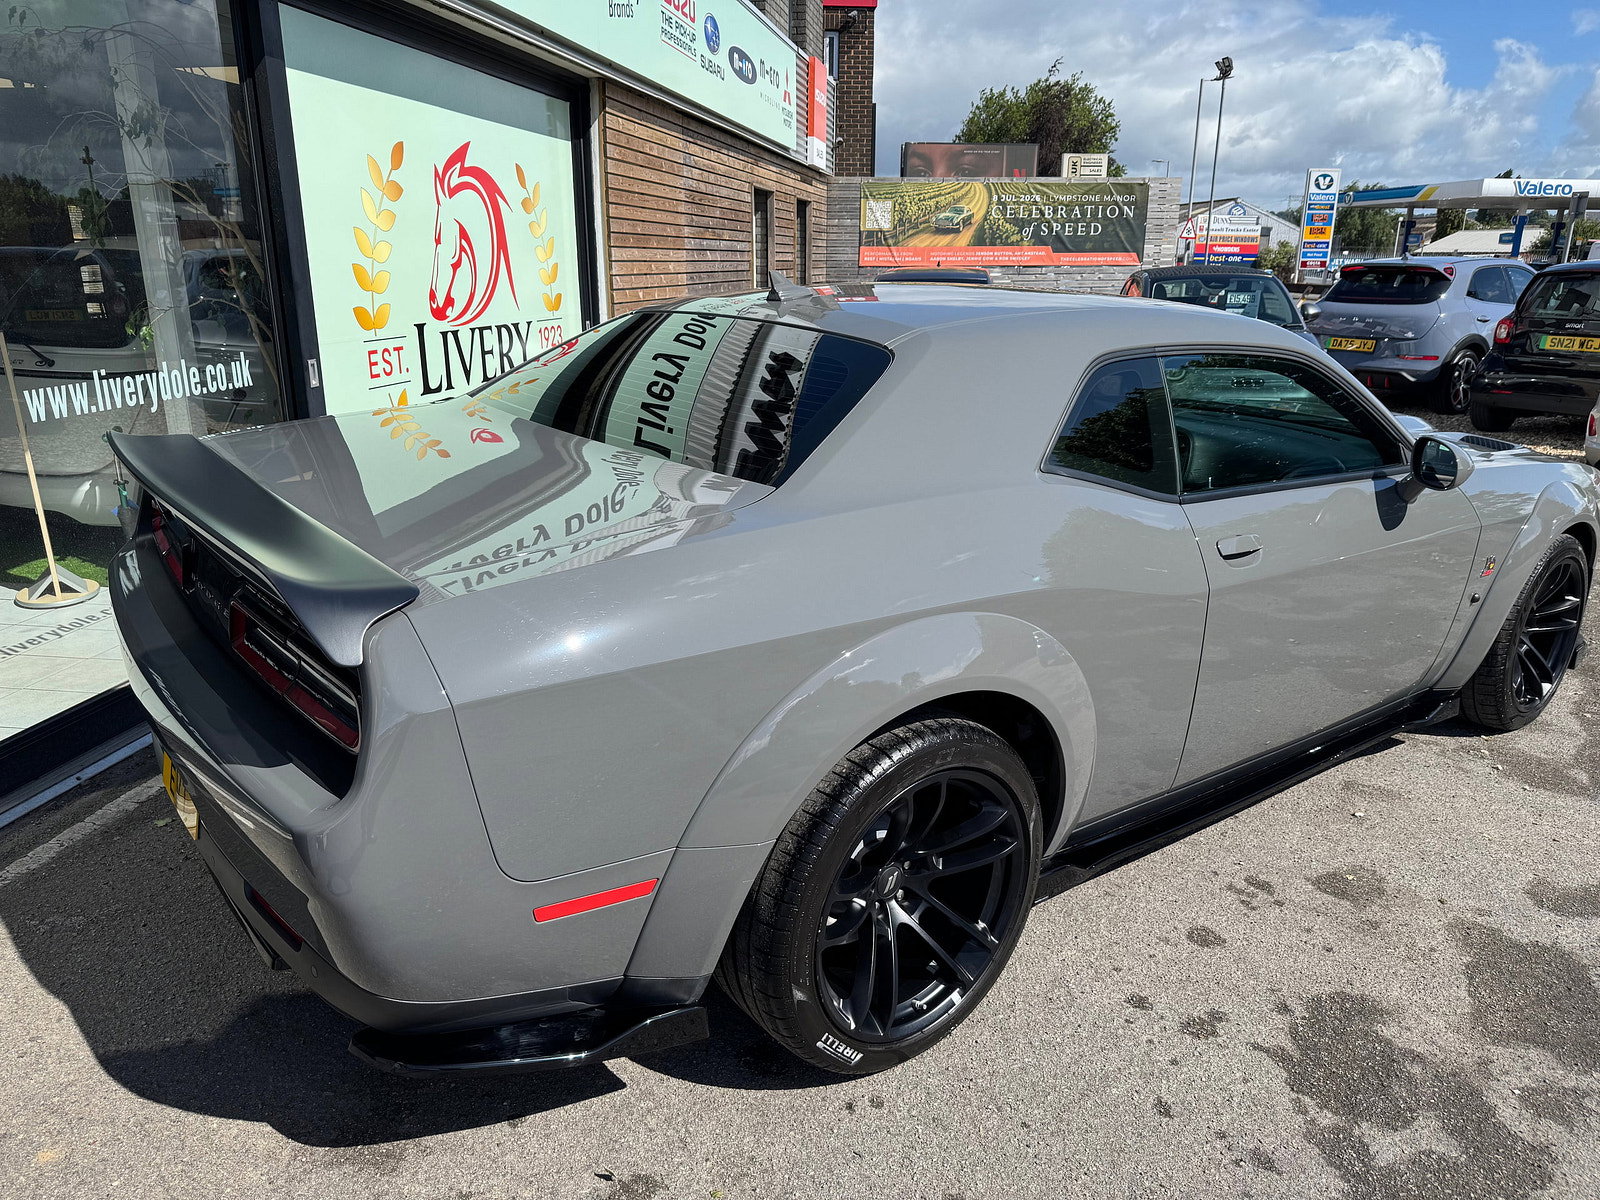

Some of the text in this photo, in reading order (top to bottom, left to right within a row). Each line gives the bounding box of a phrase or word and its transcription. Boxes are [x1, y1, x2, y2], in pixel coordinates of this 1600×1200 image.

[660, 10, 697, 44] THE PICK-UP
[700, 54, 725, 81] SUBARU
[1310, 193, 1335, 201] Valero
[1517, 180, 1573, 196] Valero
[991, 205, 1136, 219] CELEBRATION
[1022, 222, 1102, 241] of SPEED
[538, 325, 564, 350] 1923
[1331, 338, 1374, 349] DA75 JYJ
[1549, 338, 1600, 350] SN21 WGJ
[367, 345, 410, 379] EST.
[414, 320, 533, 396] LIVERY
[23, 351, 254, 423] www.liverydole.co.uk
